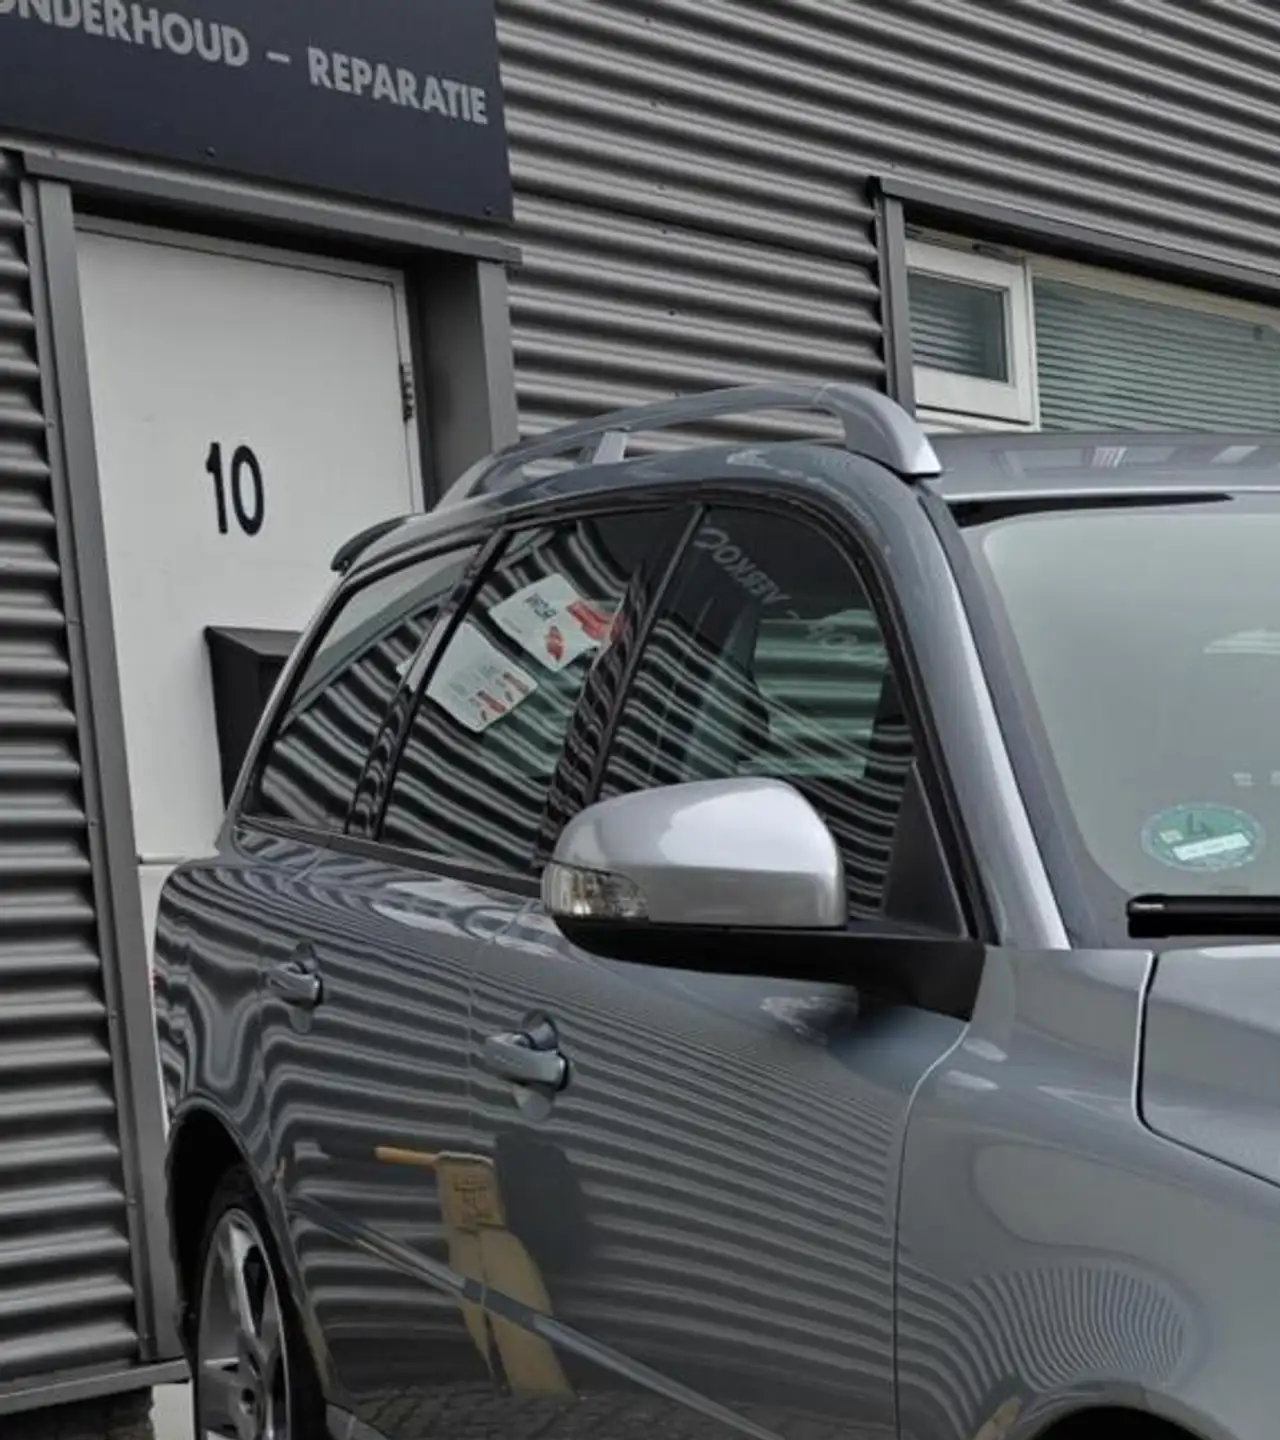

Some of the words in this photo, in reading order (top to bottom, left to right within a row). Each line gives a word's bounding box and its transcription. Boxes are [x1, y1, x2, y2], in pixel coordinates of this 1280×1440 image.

[0, 0, 249, 67] NDERHOUD
[308, 45, 489, 125] REPARATIE
[205, 441, 265, 537] 10
